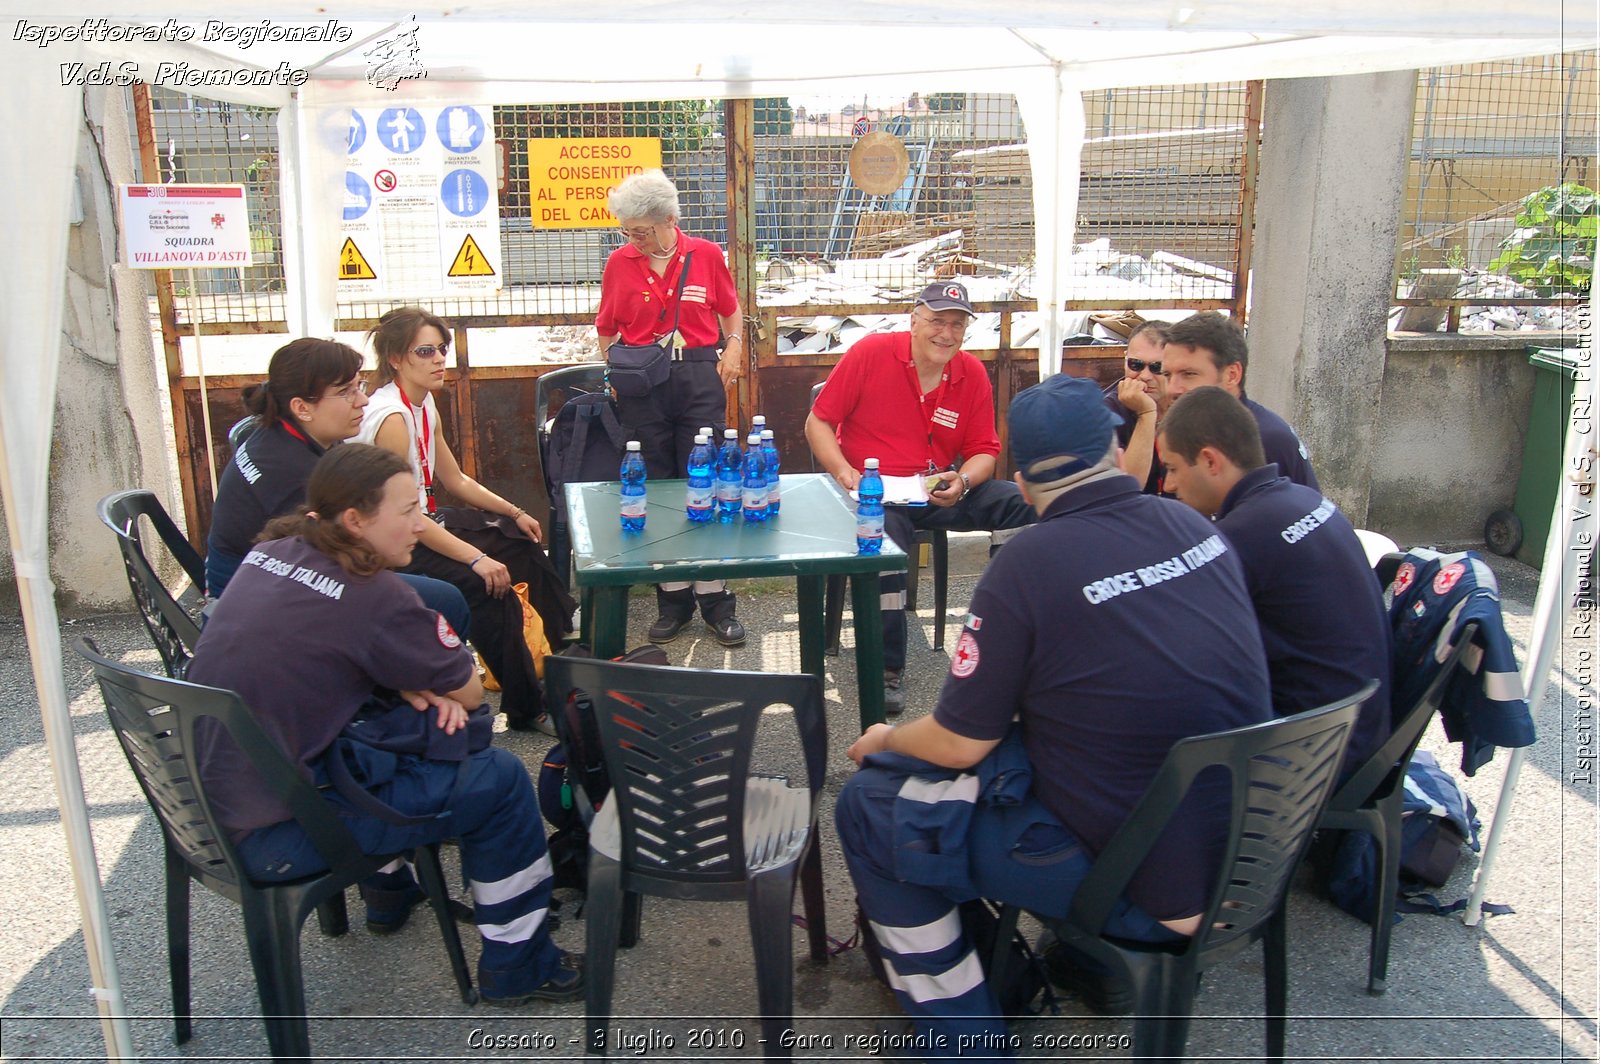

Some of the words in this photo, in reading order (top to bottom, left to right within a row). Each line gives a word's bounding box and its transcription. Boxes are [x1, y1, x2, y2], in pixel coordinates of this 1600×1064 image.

[559, 145, 632, 160] ACCESSO
[548, 165, 644, 180] CONSENTITO
[537, 187, 557, 201] AL
[541, 208, 571, 222] DEL
[164, 237, 215, 247] SQUADRA
[134, 251, 205, 262] VILLANOVA
[207, 251, 247, 261] D'ASTI
[1280, 513, 1321, 544] CROCE
[288, 566, 345, 600] ITALIANA
[1082, 571, 1143, 605] CROCE
[1135, 557, 1191, 587] ROSSA
